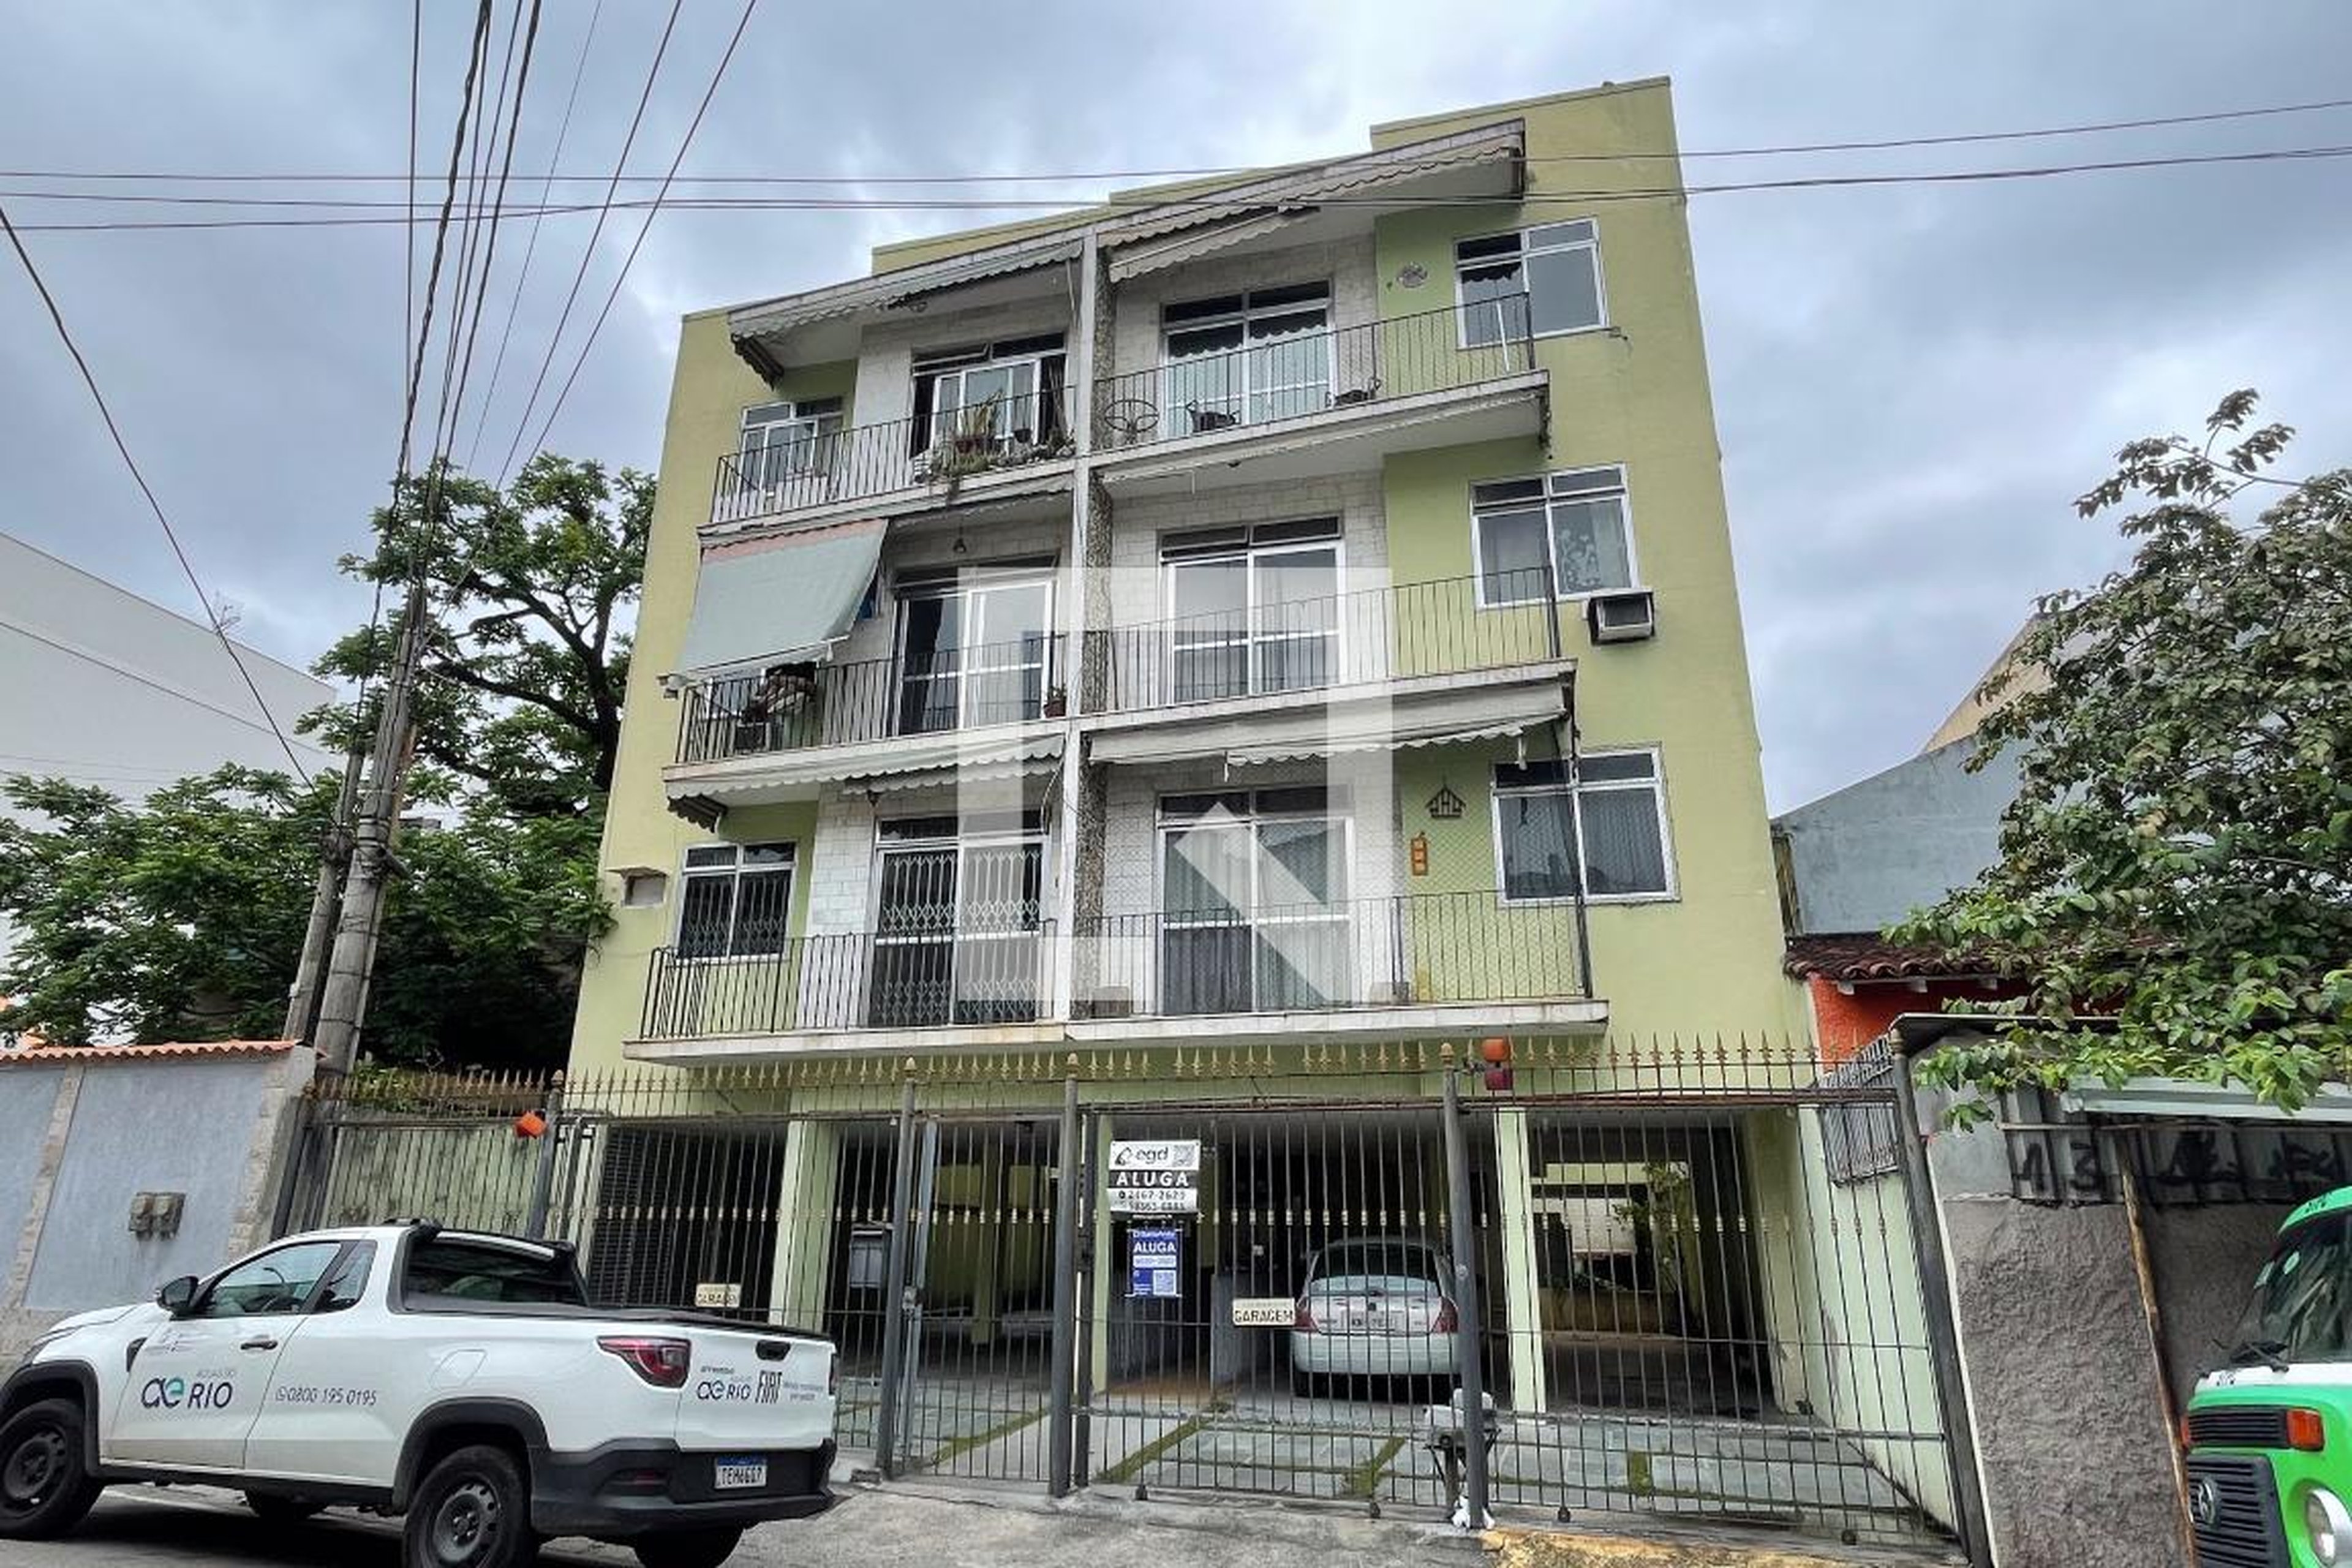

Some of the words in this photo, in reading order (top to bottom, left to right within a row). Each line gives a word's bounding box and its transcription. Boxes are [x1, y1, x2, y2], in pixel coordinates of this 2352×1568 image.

[1116, 1171, 1189, 1186] ALUGA
[1133, 1242, 1177, 1253] ALUGA
[1235, 1310, 1293, 1322] GARAGEM
[187, 1382, 233, 1408] RIO
[322, 1387, 344, 1403] 195
[346, 1389, 377, 1406] 0195
[726, 1384, 752, 1400] RIO
